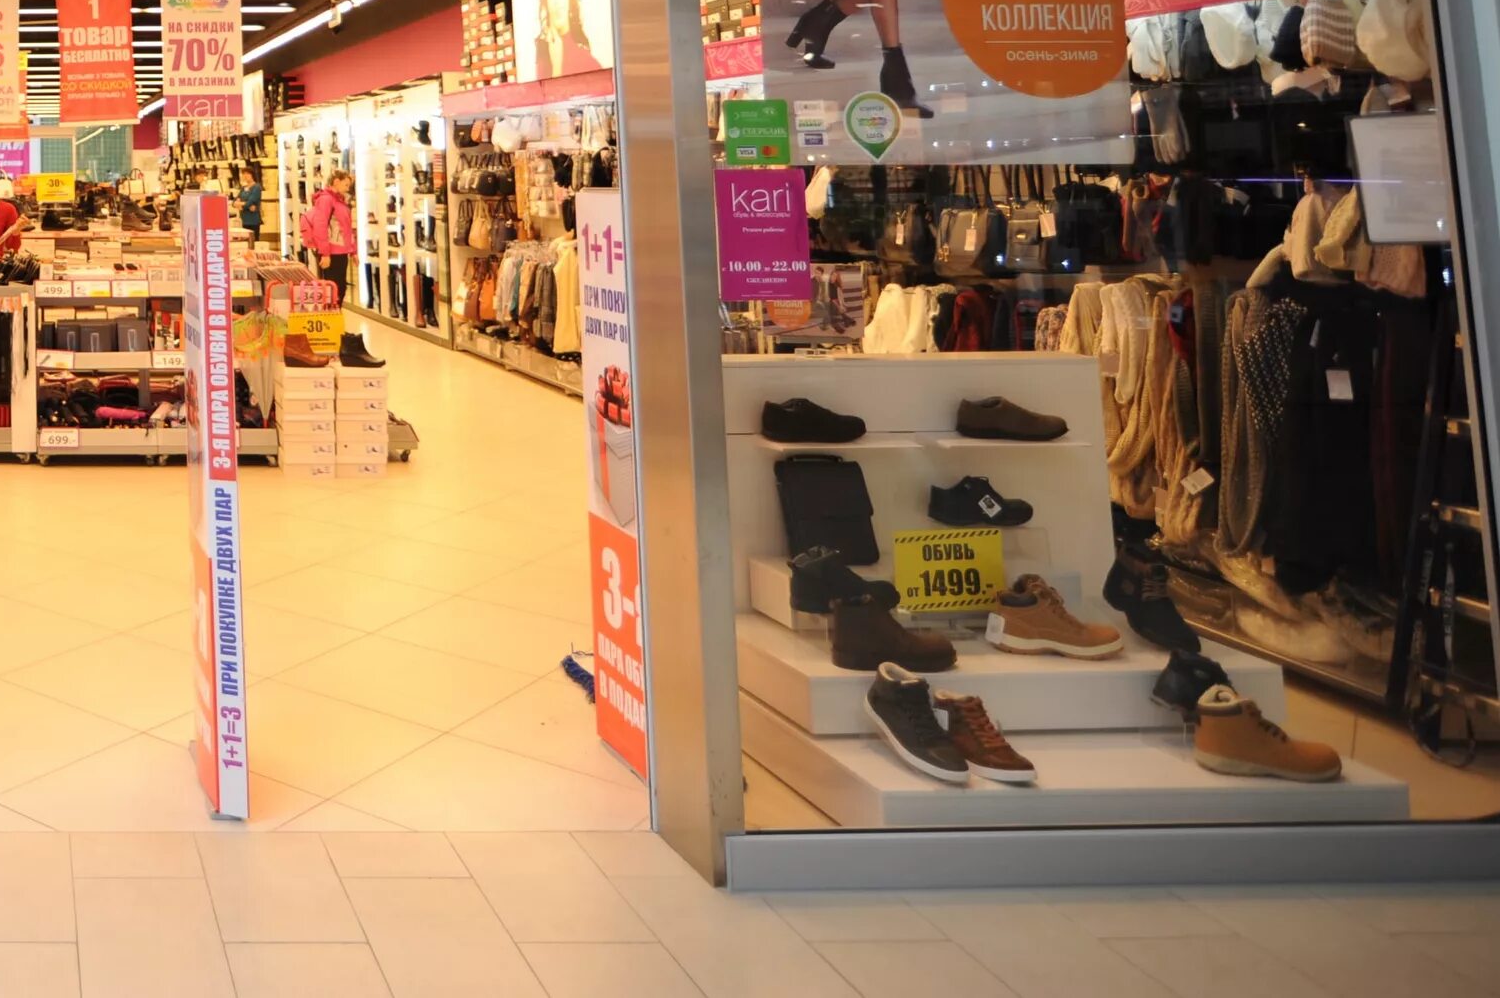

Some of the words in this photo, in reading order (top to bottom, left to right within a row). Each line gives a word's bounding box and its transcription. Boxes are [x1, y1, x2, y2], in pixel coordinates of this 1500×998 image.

[168, 21, 183, 33] НА
[186, 21, 234, 33] СКИДКИ
[981, 4, 1114, 33] КОЛЛЕКЦИЯ
[61, 25, 129, 47] товар
[62, 48, 132, 64] БЕСПЛАТНО
[168, 37, 235, 72] 70%
[1006, 50, 1099, 62] осень-зима
[169, 76, 175, 87] В
[178, 75, 236, 87] МАГАЗИНАХ
[177, 94, 230, 119] kari
[731, 183, 791, 212] kari
[206, 229, 226, 311] ПОДАРОК
[729, 261, 761, 272] 10.00
[772, 261, 807, 272] 22.00
[584, 285, 599, 306] ПРИ
[208, 314, 226, 326] В
[302, 320, 330, 333] -30%
[603, 321, 618, 340] ПАР
[210, 329, 228, 387] ОБУВИ
[210, 389, 230, 435] ПАРА
[212, 438, 232, 469] 3-Я
[214, 488, 233, 522] ПАР
[216, 526, 237, 574] ДВУХ
[922, 543, 974, 561] ОБУВЬ
[920, 568, 993, 596] 1499.-
[217, 577, 237, 657] ПОКУПКЕ
[598, 631, 624, 675] ПАРА
[221, 660, 239, 696] ПРИ
[599, 669, 607, 698] В
[221, 705, 243, 769] 1+1=3
